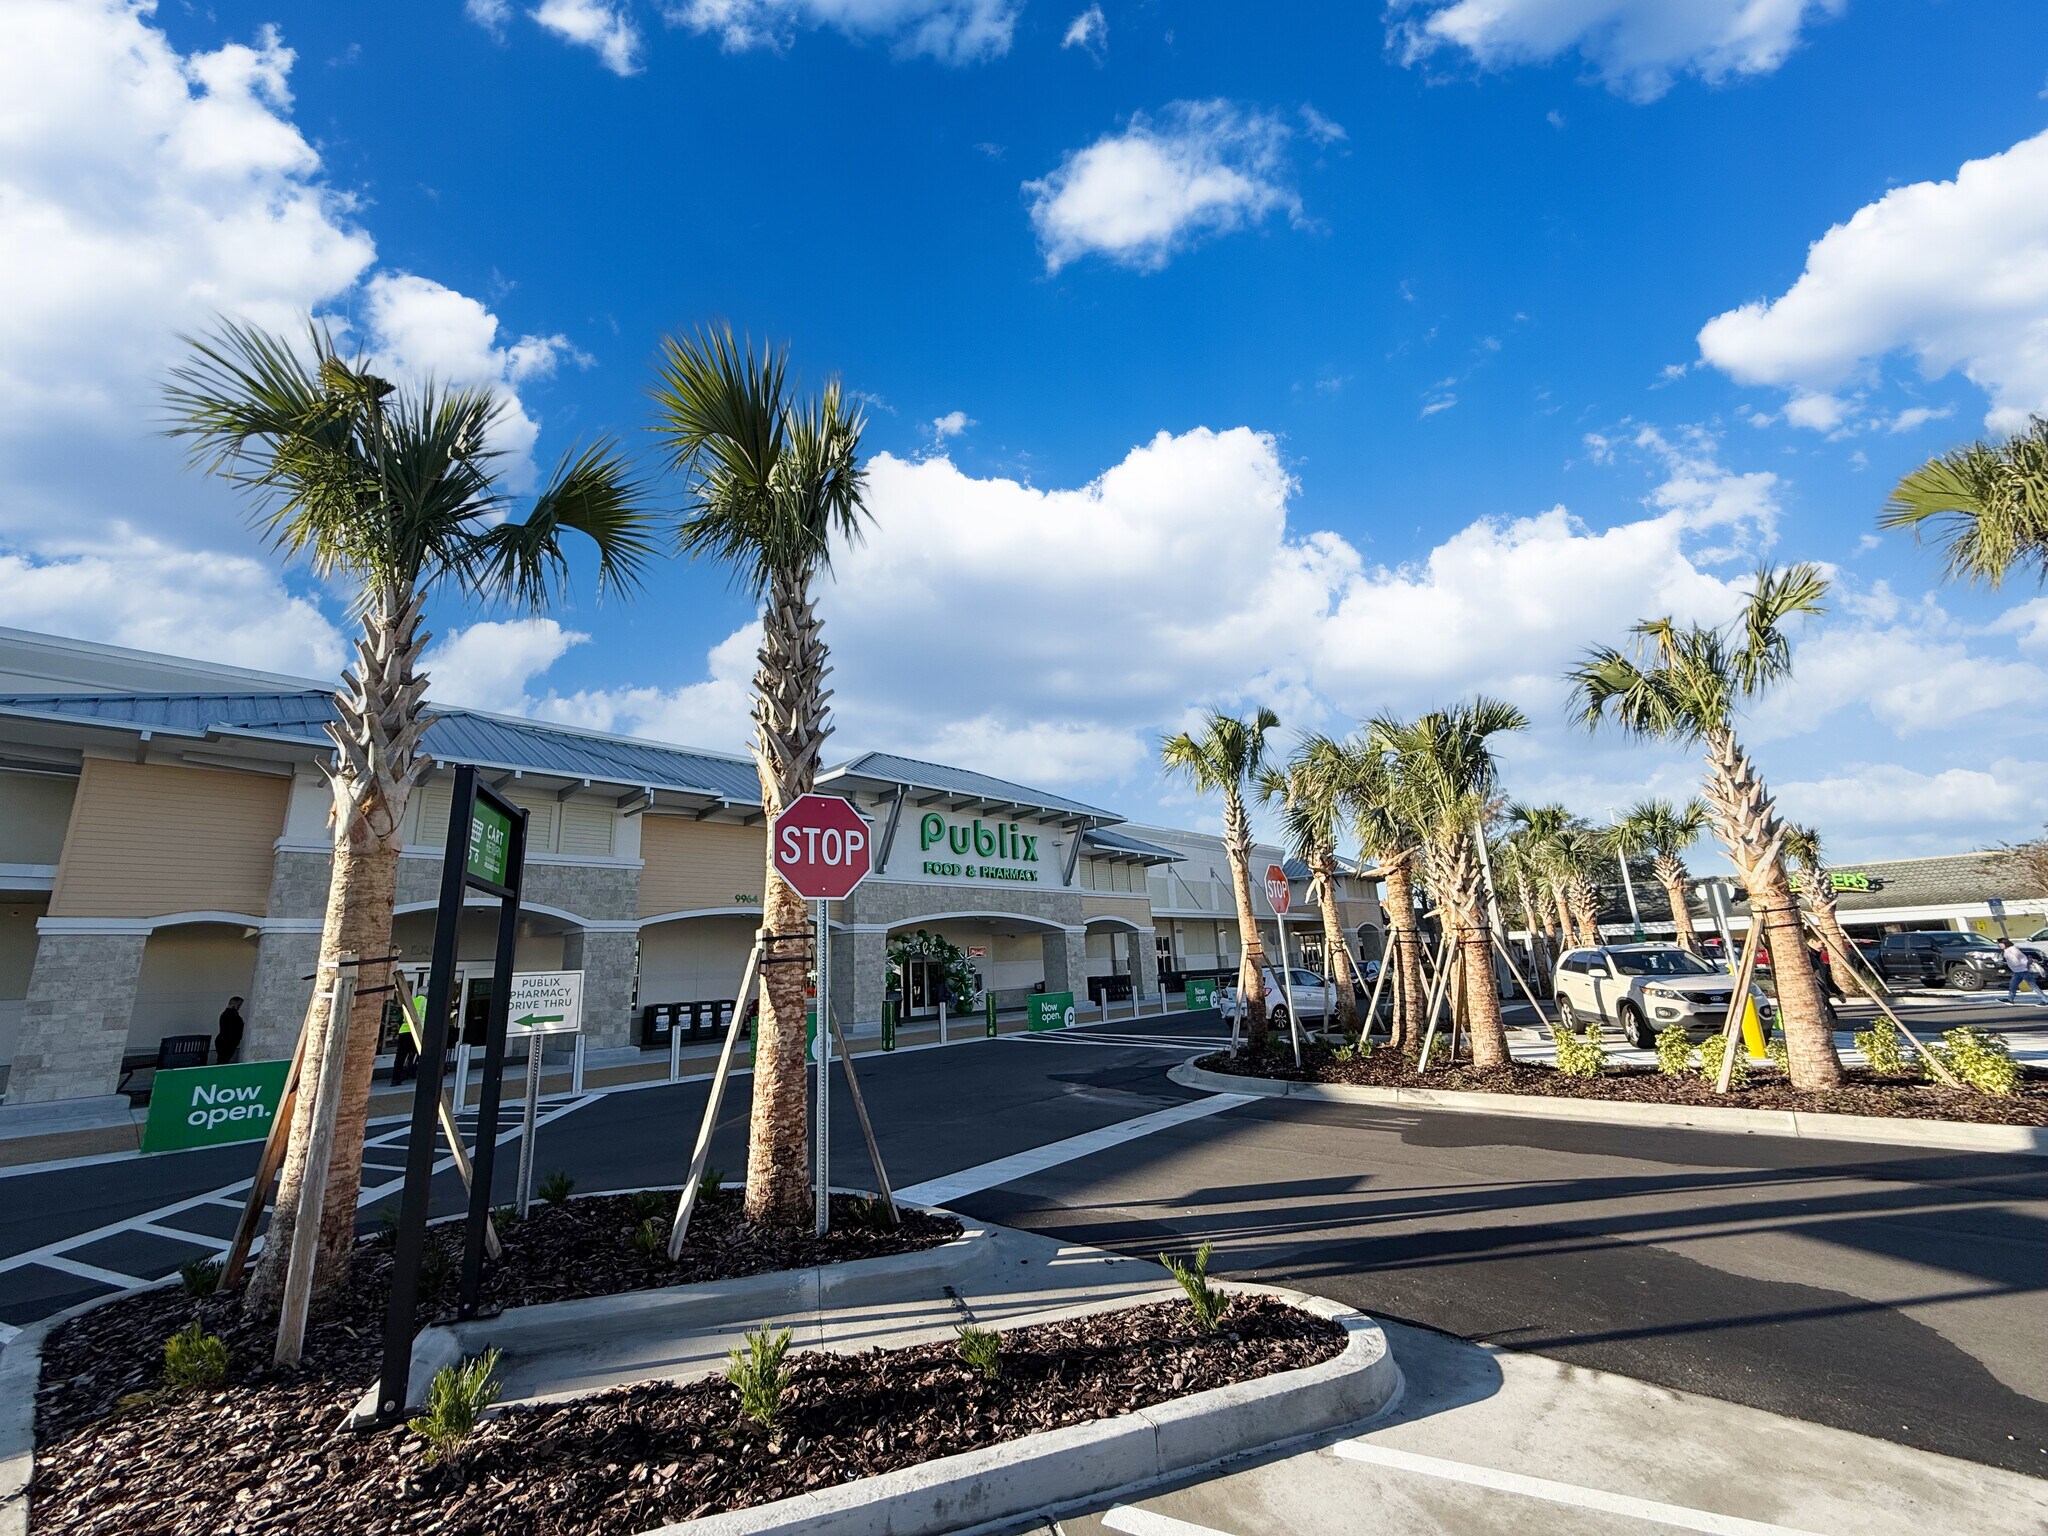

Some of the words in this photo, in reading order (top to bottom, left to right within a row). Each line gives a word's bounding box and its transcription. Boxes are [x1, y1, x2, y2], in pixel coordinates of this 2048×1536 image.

[487, 824, 504, 846] CART
[920, 812, 1039, 862] Publix
[780, 825, 865, 866] STOP
[924, 861, 962, 876] FOOD
[966, 864, 976, 877] &
[980, 865, 1038, 881] PHARMACY
[1267, 880, 1287, 899] STOP
[522, 978, 560, 988] PUBLIX
[510, 988, 571, 999] PHARMACY
[508, 1000, 539, 1010] DRIVE
[544, 998, 572, 1008] THRU
[1041, 1002, 1057, 1012] Now
[1041, 1012, 1062, 1023] open.
[191, 1084, 262, 1107] Now
[187, 1103, 271, 1130] open.
